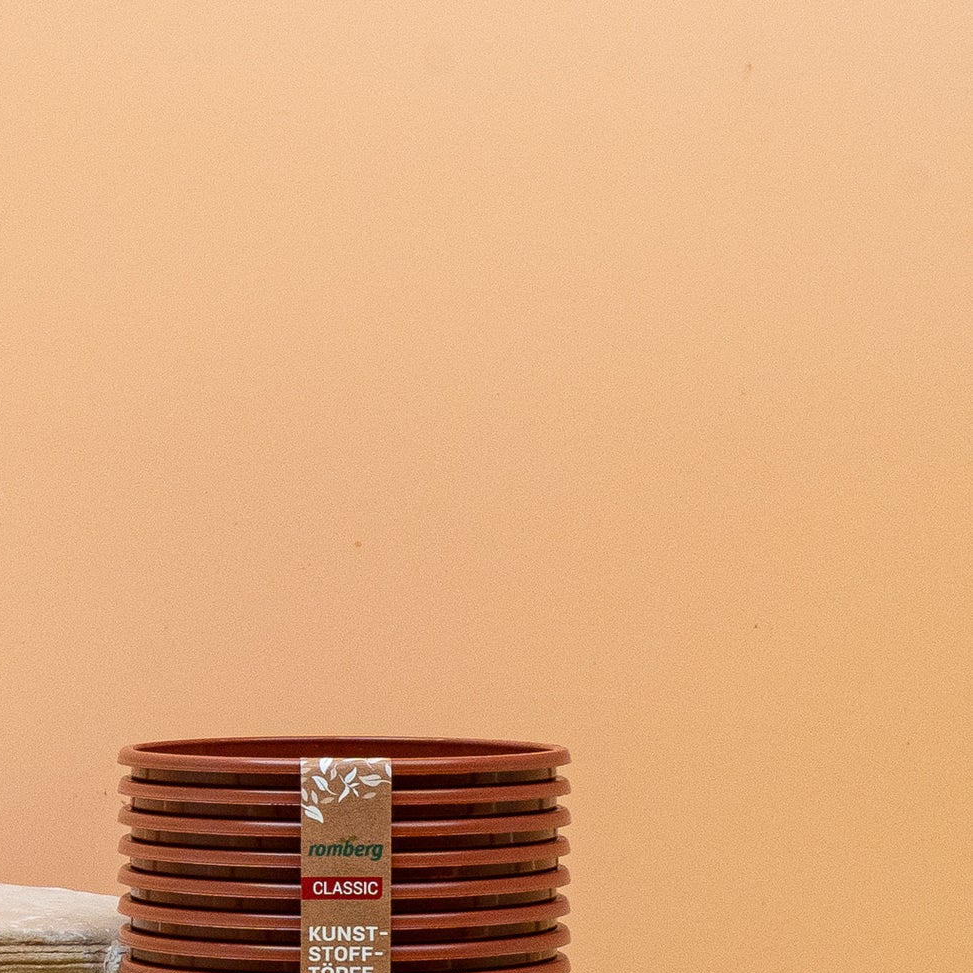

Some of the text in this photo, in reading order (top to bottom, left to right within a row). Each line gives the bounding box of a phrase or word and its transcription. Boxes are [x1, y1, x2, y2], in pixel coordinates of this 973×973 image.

[308, 839, 383, 861] romberg
[312, 881, 379, 895] CLASSIC
[308, 926, 388, 942] KUNST-
[308, 946, 384, 962] STOFF-
